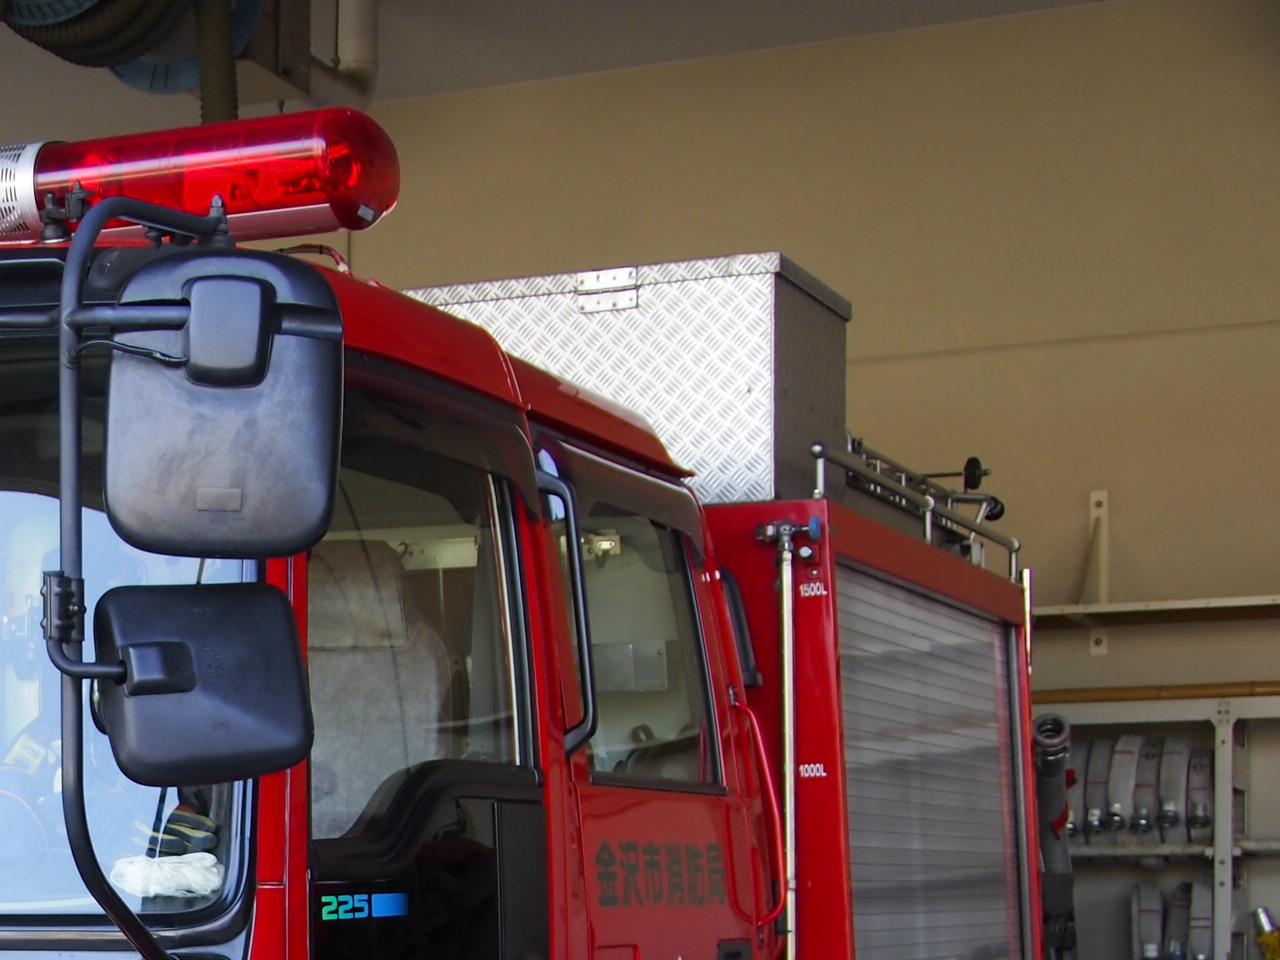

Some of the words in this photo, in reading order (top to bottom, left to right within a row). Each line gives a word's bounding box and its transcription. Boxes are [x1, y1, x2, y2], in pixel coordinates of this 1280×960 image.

[799, 582, 828, 597] 1500L
[799, 763, 827, 777] 1000L
[596, 838, 726, 907] 金沢市消防局
[321, 894, 369, 920] 225
